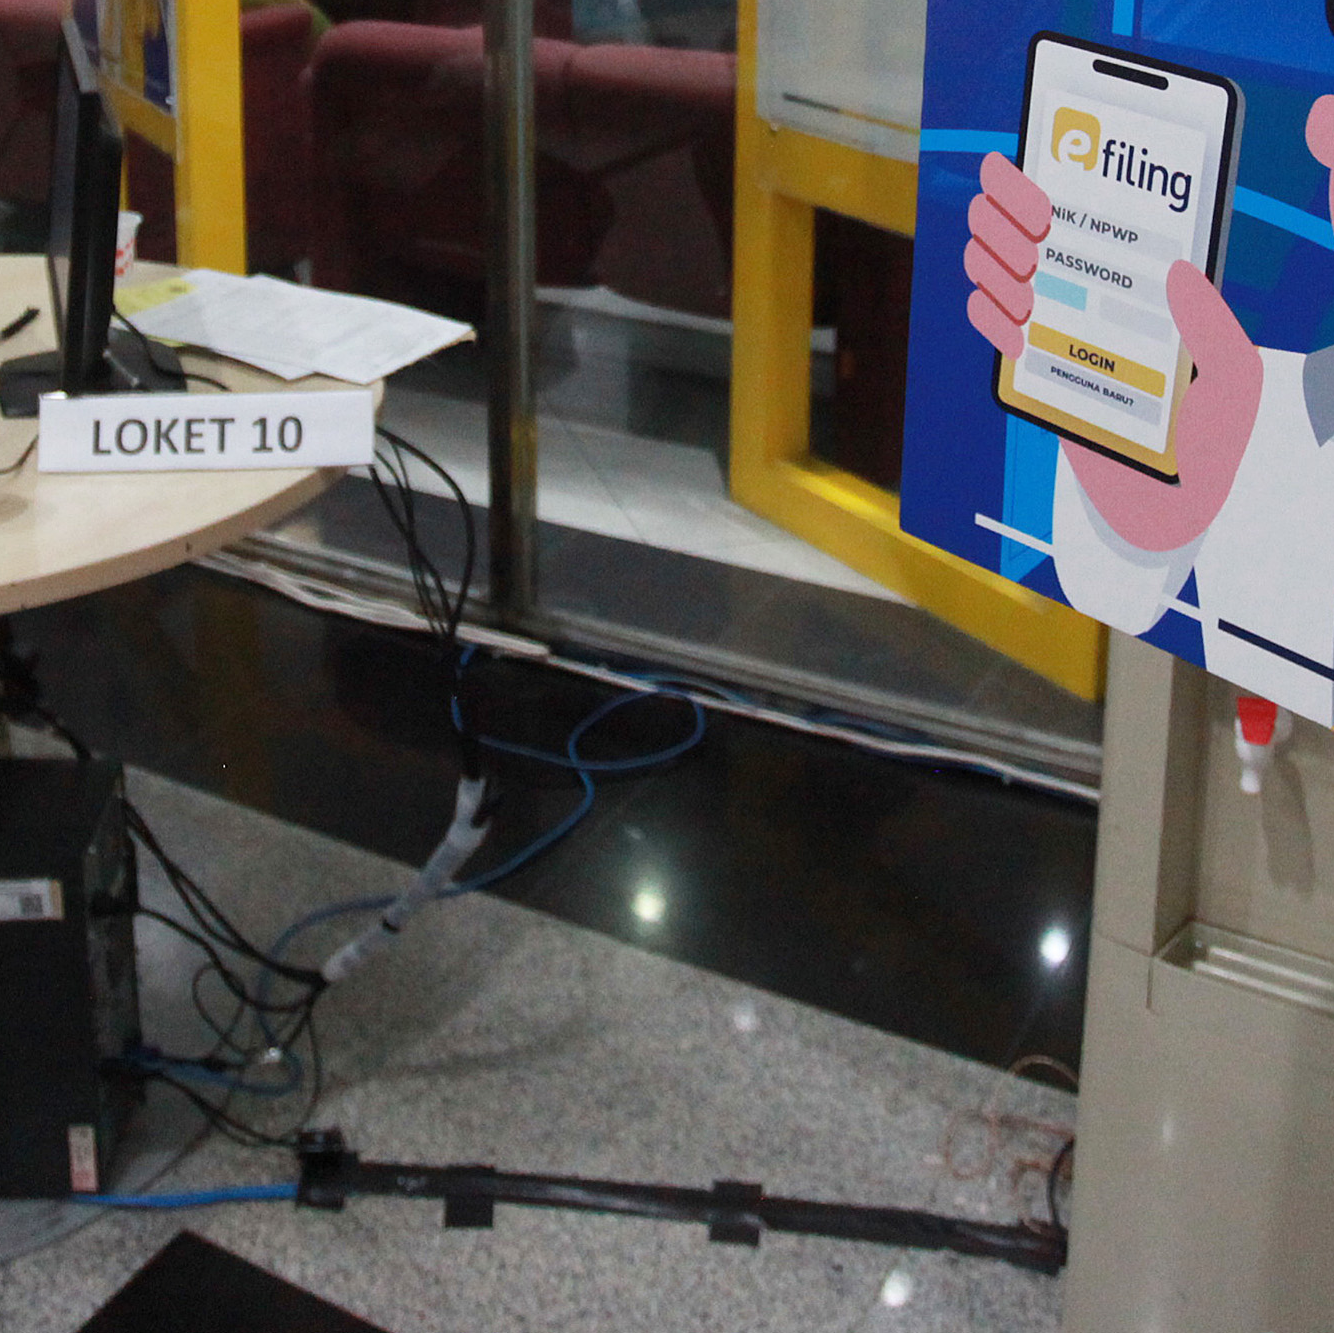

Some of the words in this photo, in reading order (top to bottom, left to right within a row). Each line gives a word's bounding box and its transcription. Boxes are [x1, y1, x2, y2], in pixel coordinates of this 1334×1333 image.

[1102, 138, 1193, 213] filing
[1090, 217, 1139, 243] NPWP
[1046, 247, 1133, 289] PASSWORD
[1069, 344, 1116, 373] LOGIN
[1050, 366, 1100, 393] PENGGUNA
[91, 417, 236, 456] LOKET
[251, 415, 303, 454] 10
